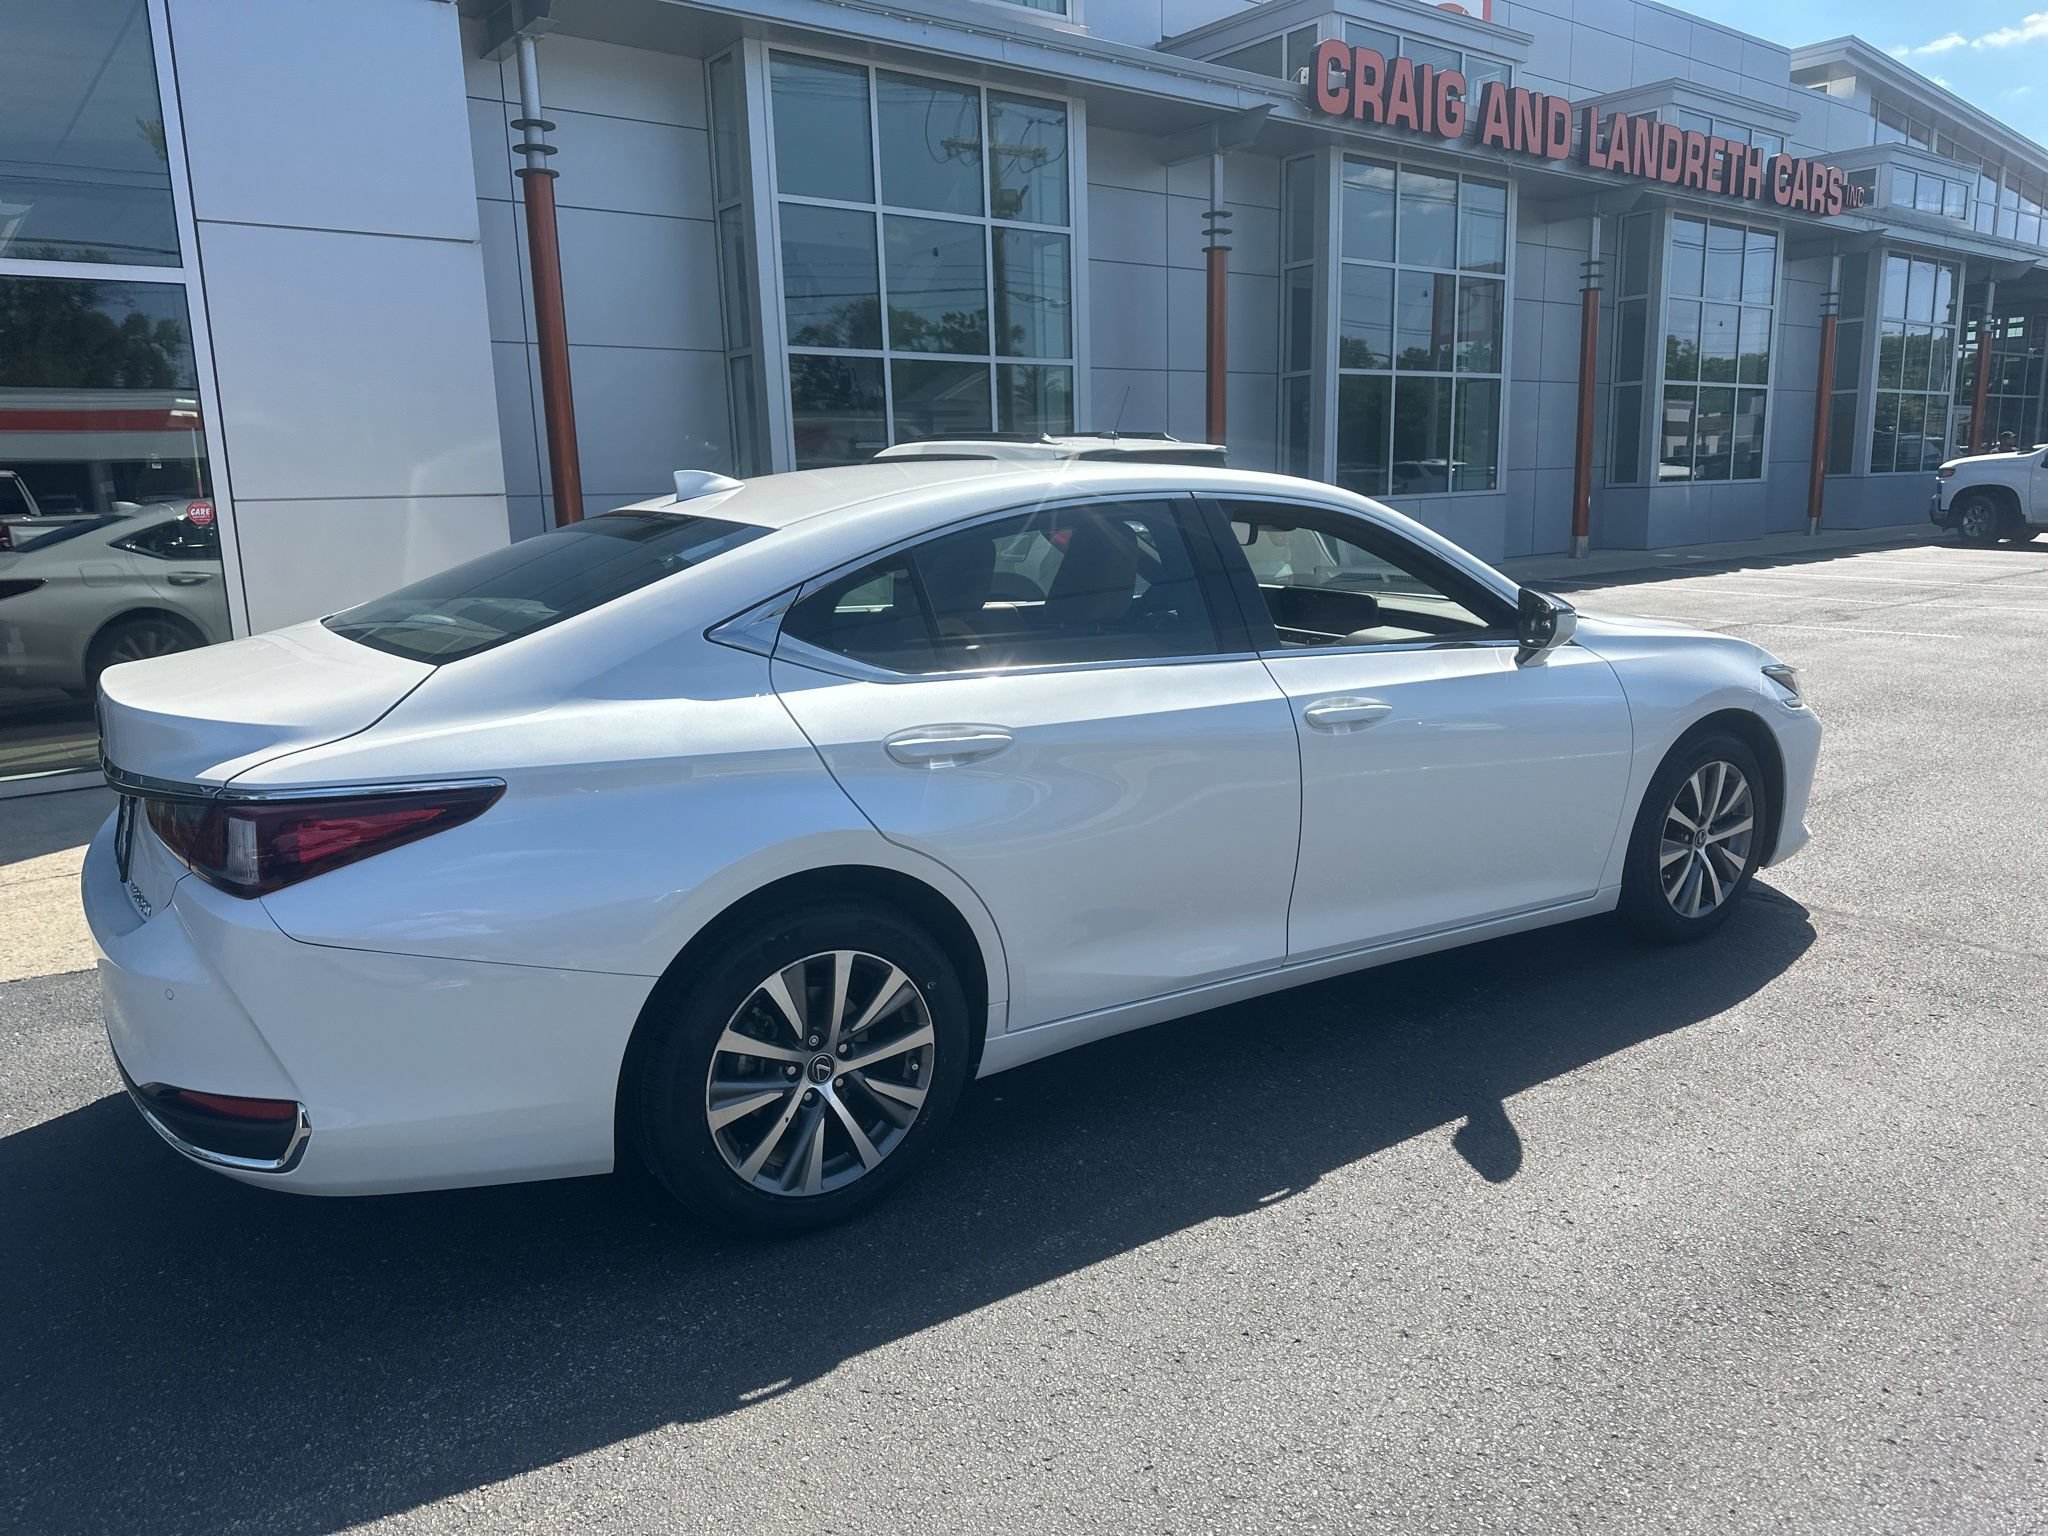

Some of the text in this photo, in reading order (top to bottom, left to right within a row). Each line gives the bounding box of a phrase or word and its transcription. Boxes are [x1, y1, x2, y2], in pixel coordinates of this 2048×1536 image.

[1313, 38, 1466, 139] CRAIG
[1479, 80, 1573, 160] AND
[1585, 105, 1764, 200] LANDRETH
[1770, 152, 1844, 216] CARS
[190, 507, 211, 516] CARE
